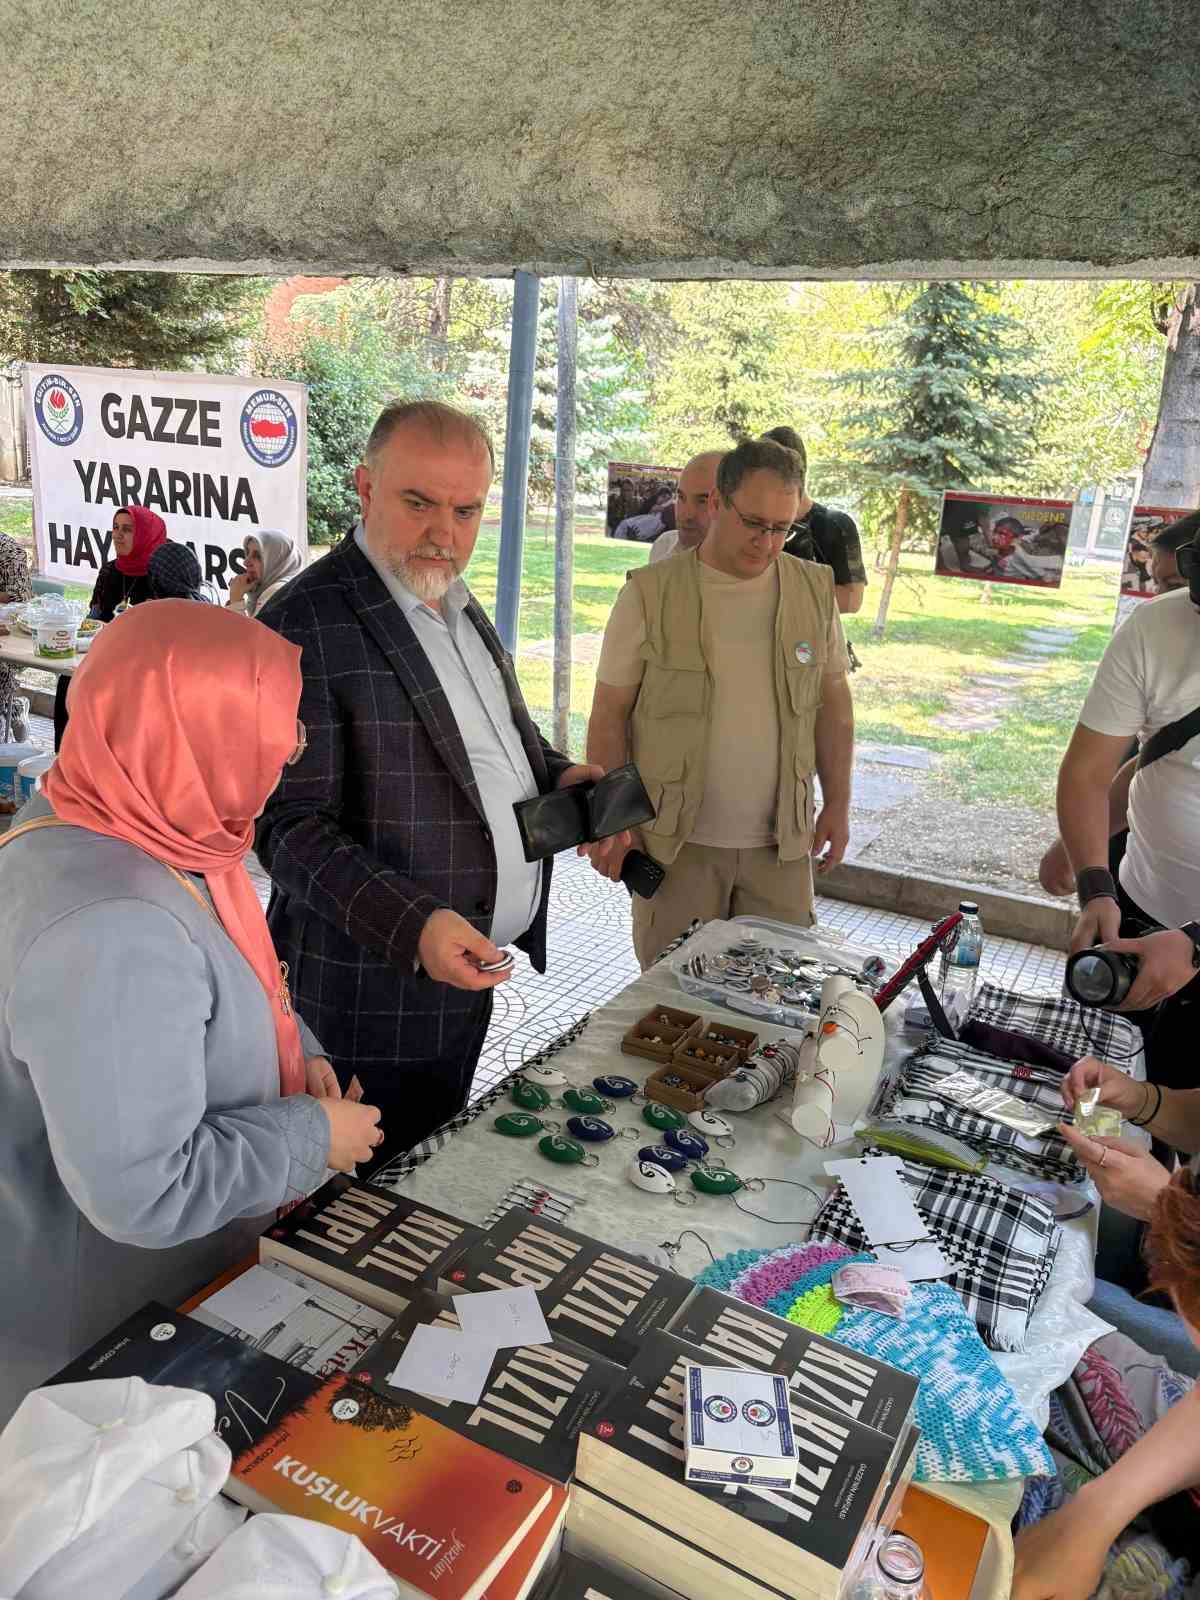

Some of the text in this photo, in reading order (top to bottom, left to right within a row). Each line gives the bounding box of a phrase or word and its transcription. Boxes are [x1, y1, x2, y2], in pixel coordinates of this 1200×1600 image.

[100, 392, 222, 448] GAZZE
[245, 392, 293, 418] MEMUR-SEN
[73, 459, 259, 525] YARARINA
[48, 522, 113, 569] HAY
[295, 1186, 398, 1255] KAPI
[355, 1209, 465, 1282] KIZIL
[546, 1252, 660, 1337] KIZIL
[465, 1343, 591, 1445] KIZIL
[789, 1340, 878, 1419] KIZ
